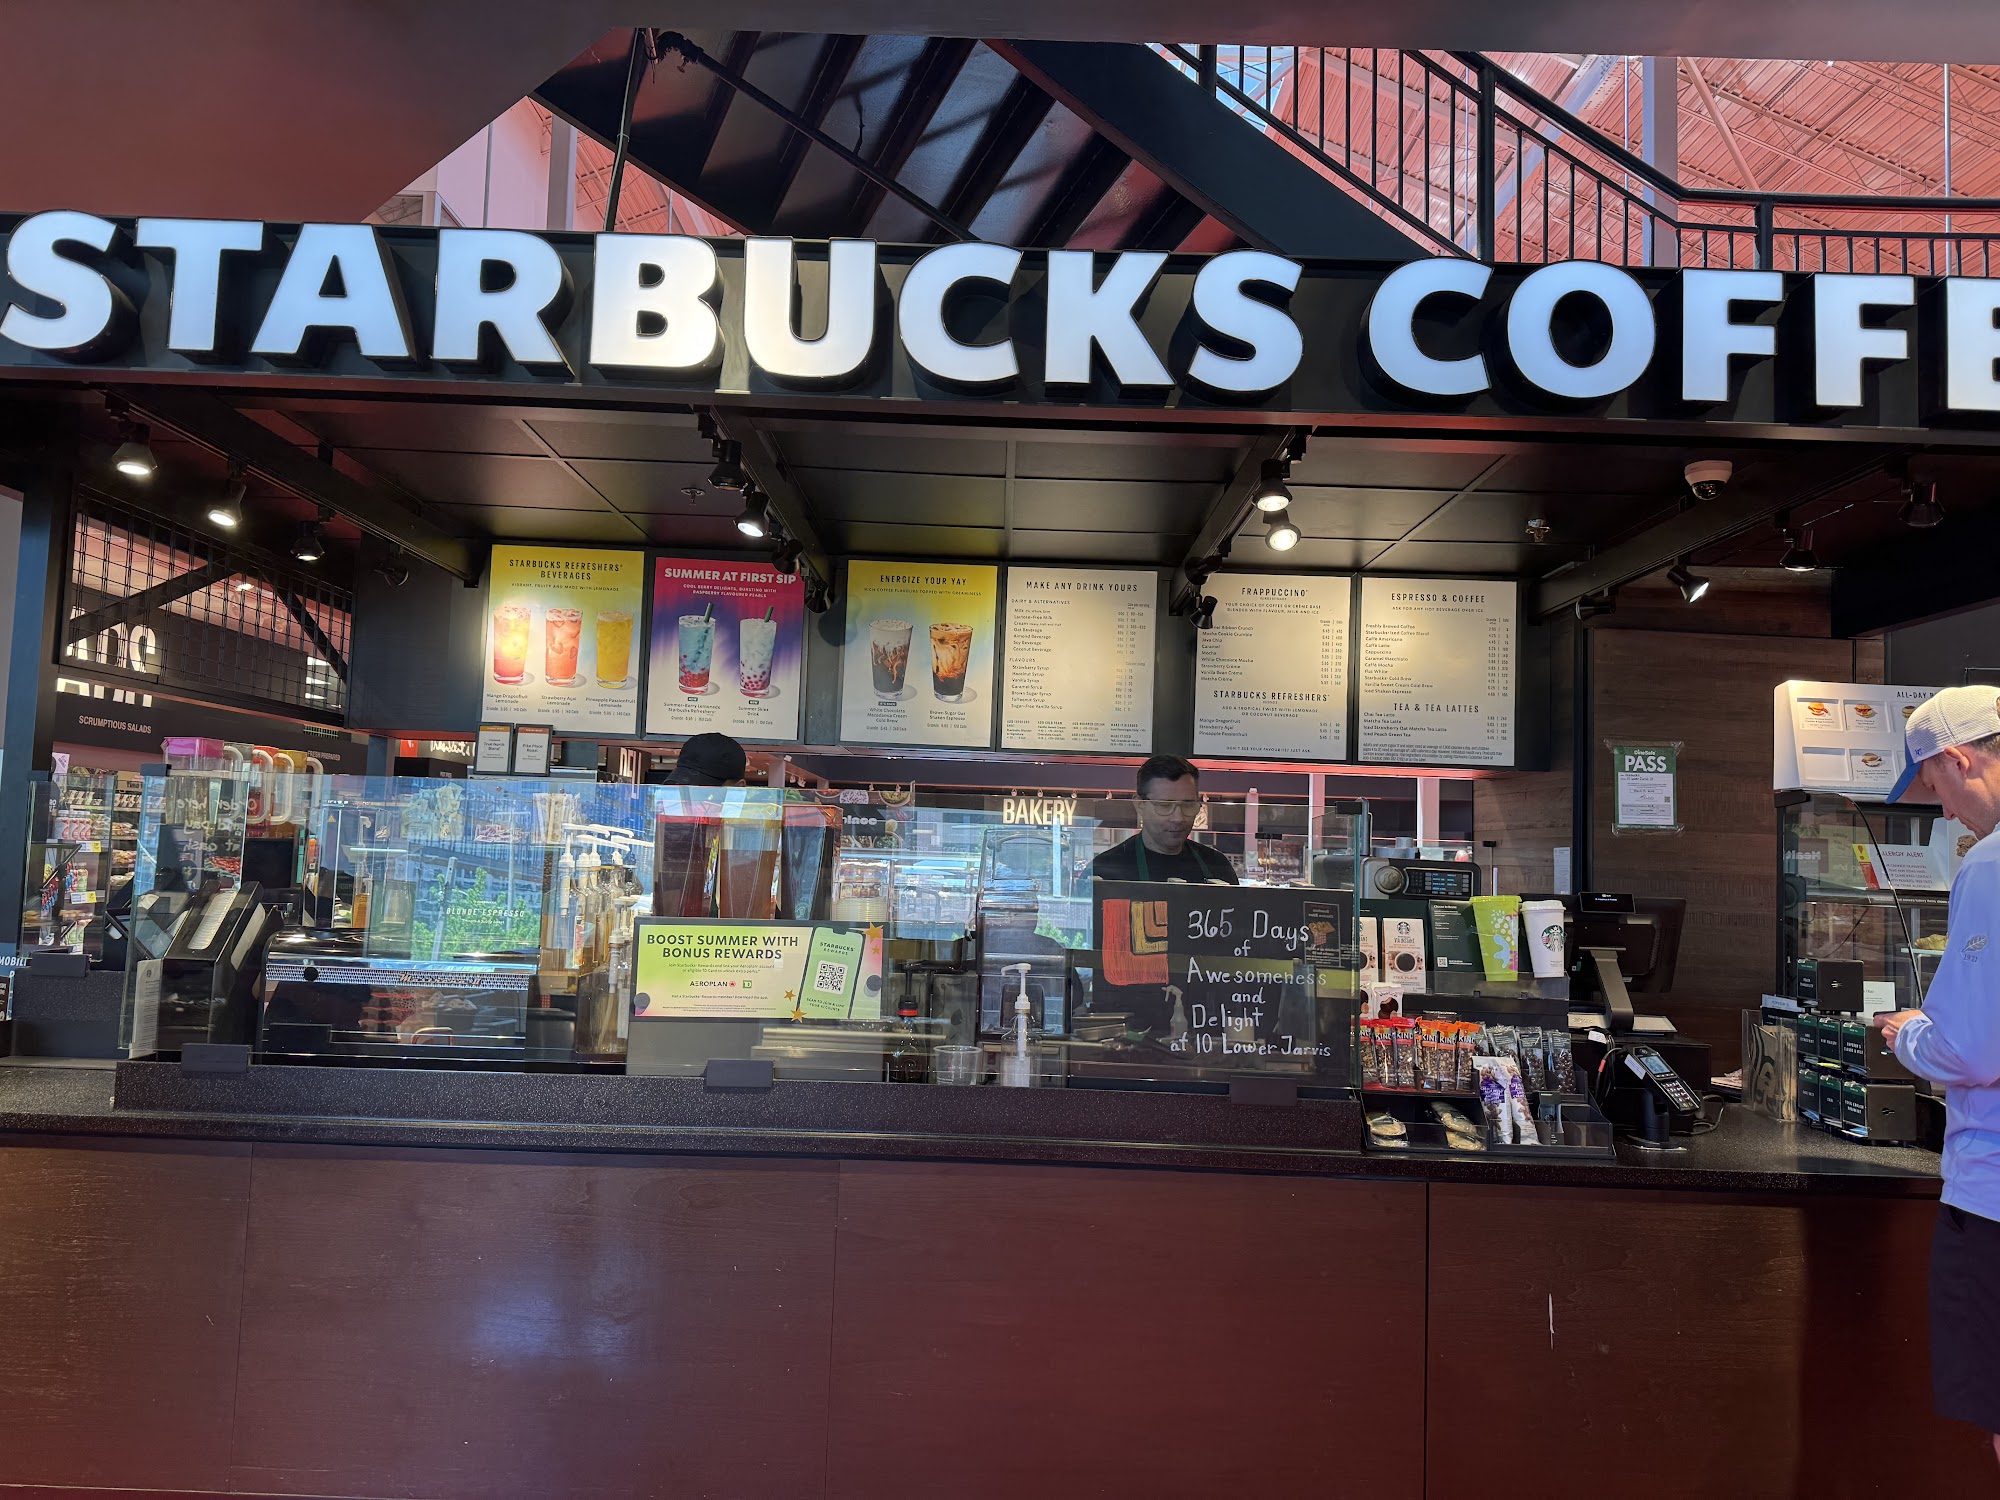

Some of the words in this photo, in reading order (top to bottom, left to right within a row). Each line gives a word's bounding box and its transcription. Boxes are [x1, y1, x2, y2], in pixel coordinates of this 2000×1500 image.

[0, 209, 1305, 394] STARBUCKS
[509, 559, 561, 569] STARBUCKS
[540, 571, 592, 581] BEVERAGES
[664, 567, 721, 581] SUMMER
[722, 571, 739, 582] AT
[740, 572, 775, 584] FIRST
[775, 574, 797, 585] SIP
[880, 575, 921, 584] ENERGIZE
[924, 576, 947, 585] YOUR
[951, 578, 967, 586] YAY
[1026, 581, 1051, 590] MAKE
[1054, 582, 1072, 590] ANY
[1076, 582, 1104, 591] DRINK
[1108, 583, 1138, 592] YOURS
[1391, 592, 1438, 602] ESPRESSO
[1442, 594, 1448, 602] &
[1452, 594, 1485, 603] COFFEE
[1213, 690, 1267, 700] STARBUCKS
[1896, 691, 1927, 699] ALL-DAY
[1394, 703, 1410, 711] TEA
[1414, 703, 1421, 712] &
[1425, 703, 1442, 712] TEA
[1446, 704, 1480, 713] LATTES
[78, 715, 127, 731] SCRUMPTIOUS
[127, 722, 152, 734] SALADS
[1624, 755, 1667, 773] PASS
[1002, 798, 1077, 826] BAKERY
[446, 907, 478, 916] BLONDE
[482, 908, 525, 918] ESPRESSO
[1187, 908, 1235, 940] 365
[1252, 909, 1310, 952] Days
[647, 934, 694, 945] BOOST
[697, 935, 758, 946] SUMMER
[762, 936, 799, 947] WITH
[819, 941, 854, 952] STARBUCKS
[662, 947, 710, 958] BONUS
[714, 948, 782, 960] REWARDS
[823, 948, 848, 956] REWARDS
[1234, 939, 1252, 957] of
[1186, 956, 1327, 986] Awesomeness
[1231, 987, 1266, 1004] and
[1192, 1003, 1264, 1032] Delight
[1170, 1032, 1189, 1052] at
[1196, 1033, 1213, 1055] 10
[1223, 1032, 1278, 1056] Lower
[1280, 1035, 1332, 1058] Jarvis
